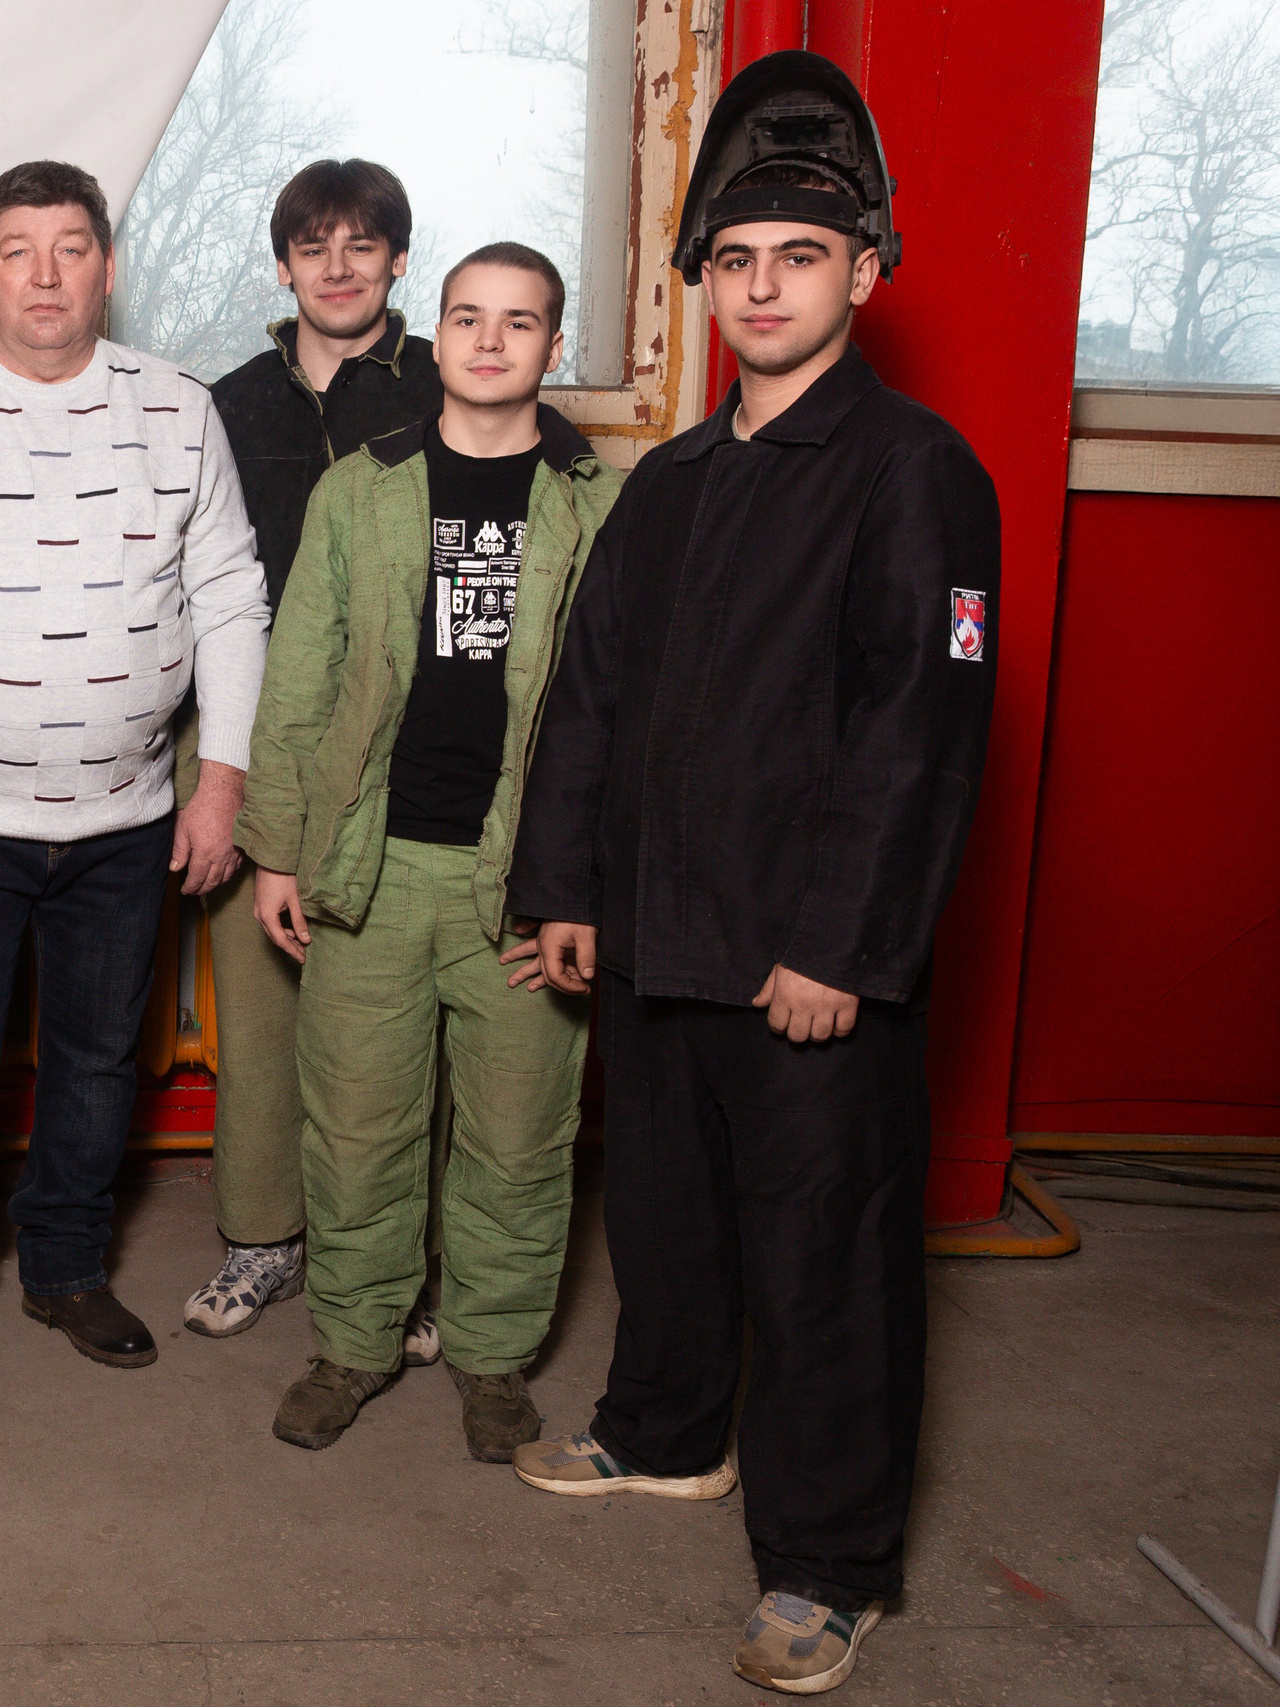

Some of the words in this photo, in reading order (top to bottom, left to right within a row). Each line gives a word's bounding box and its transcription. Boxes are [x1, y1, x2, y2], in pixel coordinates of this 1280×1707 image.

[476, 542, 504, 555] Kappa
[467, 577, 491, 586] PEOPLE
[492, 576, 502, 586] ON
[503, 577, 517, 587] THE
[452, 589, 476, 614] 67
[469, 649, 492, 660] KAPPA
